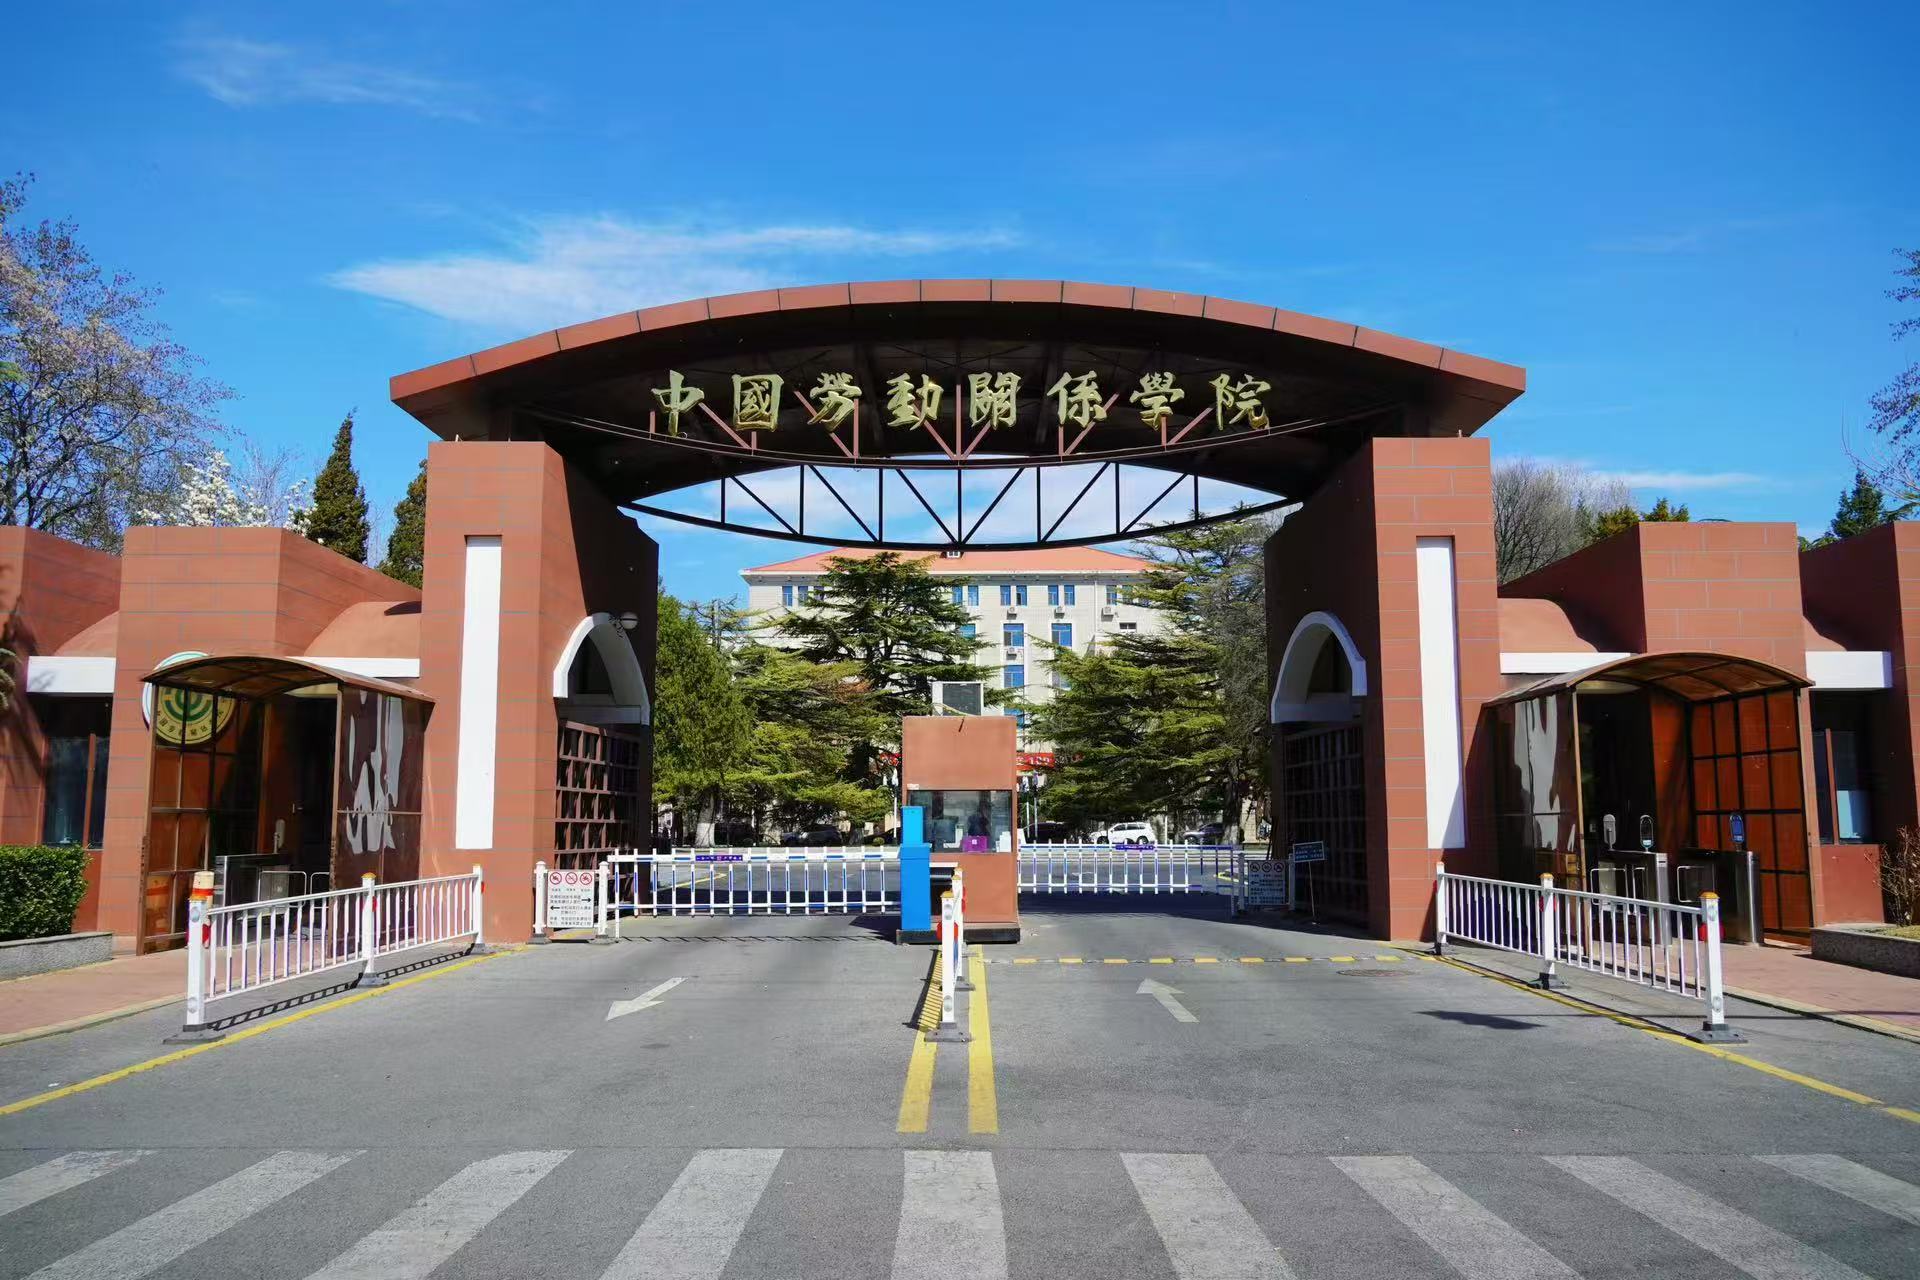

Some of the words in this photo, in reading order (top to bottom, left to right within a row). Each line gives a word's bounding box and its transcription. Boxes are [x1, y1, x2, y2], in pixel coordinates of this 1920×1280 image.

[651, 369, 1271, 434] 中國勞動關係學院
